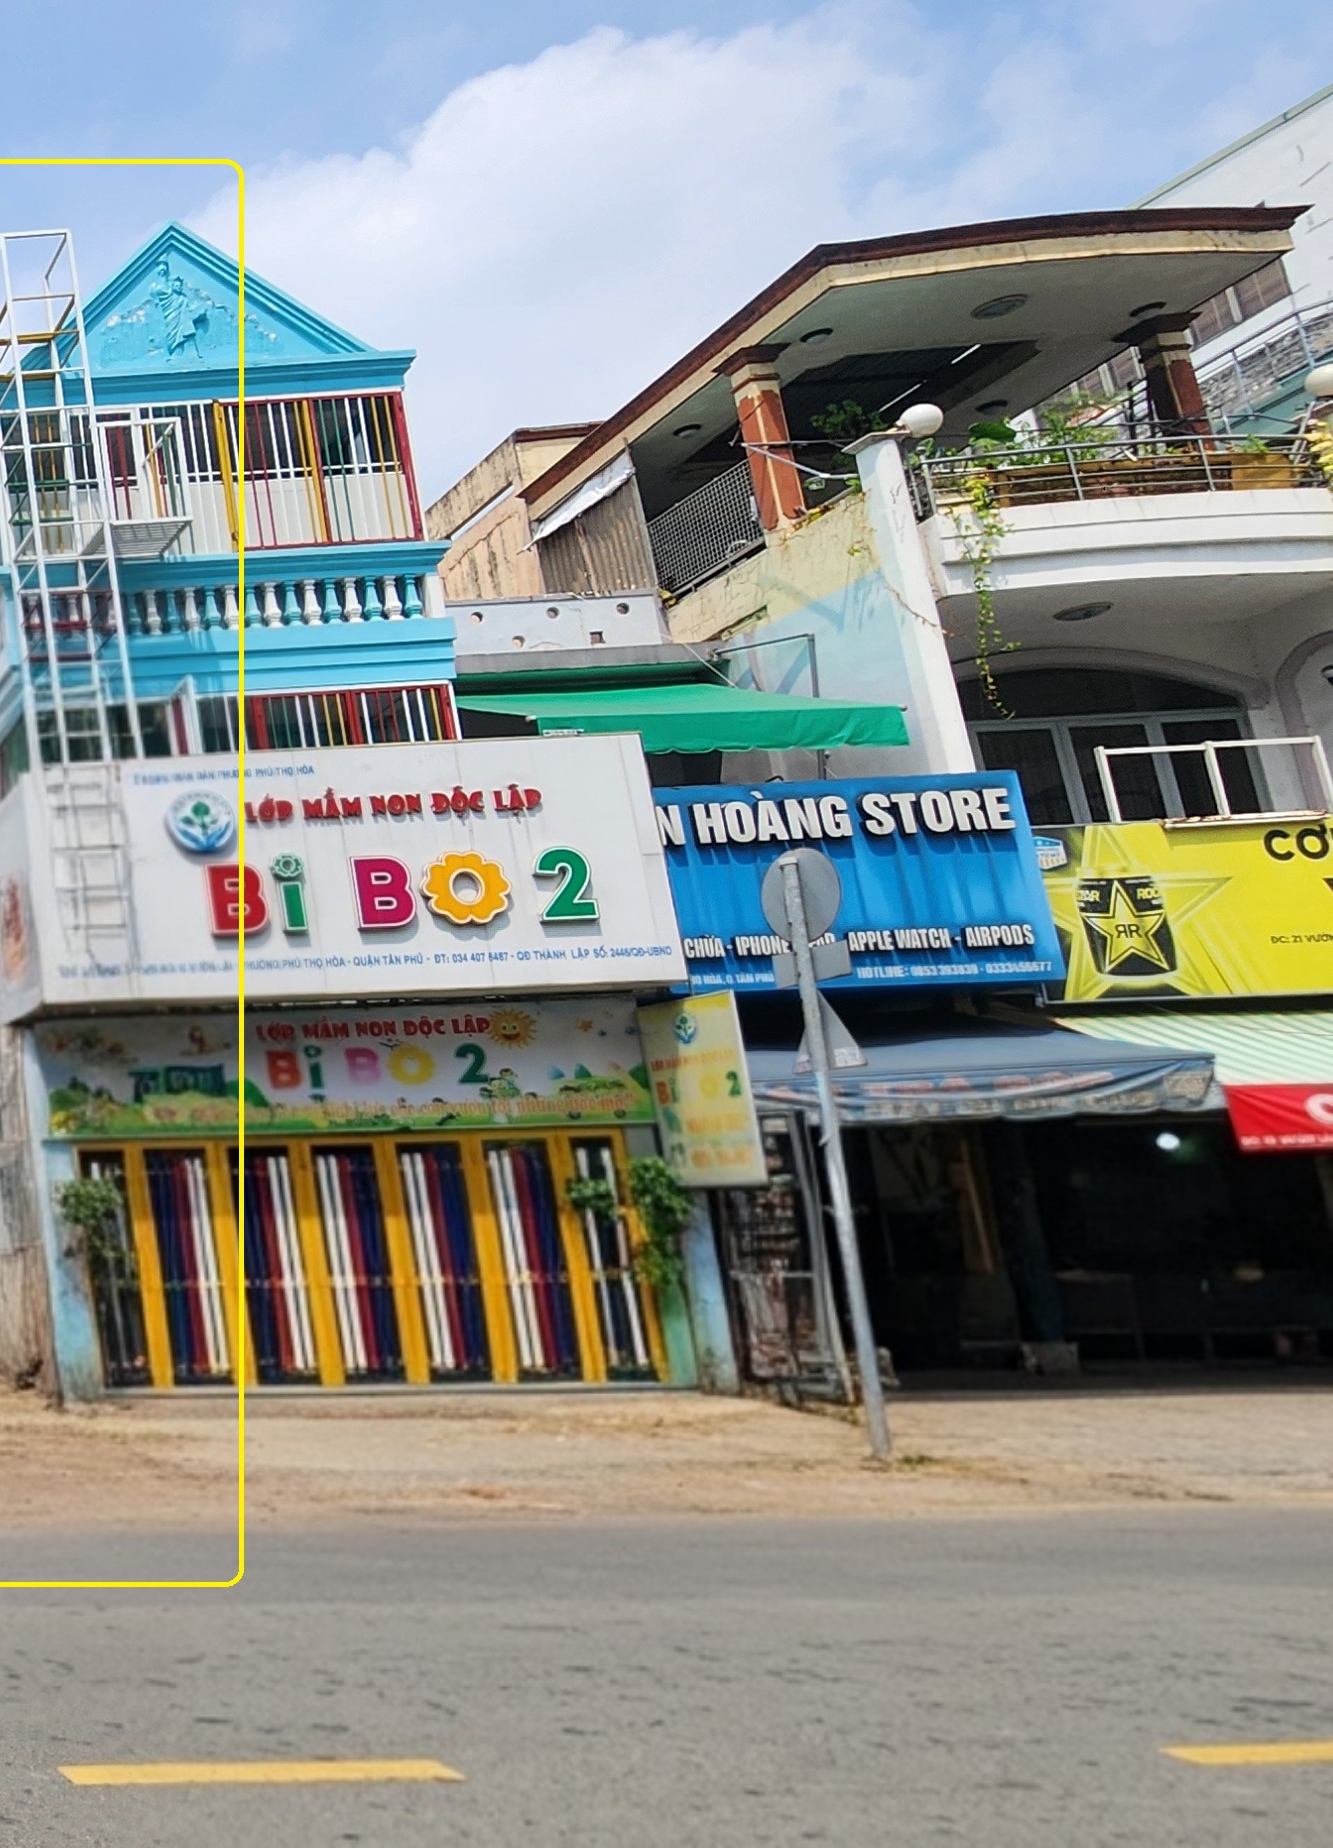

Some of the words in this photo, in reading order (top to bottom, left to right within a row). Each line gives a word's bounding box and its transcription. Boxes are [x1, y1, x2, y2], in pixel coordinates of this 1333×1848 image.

[275, 766, 293, 776] THỌ
[296, 764, 315, 775] HÒA
[369, 792, 423, 816] NON
[431, 785, 486, 819] ĐỘC
[493, 783, 543, 816] LẬP
[692, 790, 854, 844] HOÀNG
[861, 788, 1017, 836] STORE
[1264, 822, 1333, 862] CƠ
[532, 845, 601, 924] 2
[847, 929, 895, 951] APPLE
[894, 927, 952, 950] WATCH
[965, 924, 1035, 947] AIRPODS
[303, 957, 323, 971] THỌ
[325, 955, 347, 967] HÒA
[353, 954, 381, 969] QUẬN
[382, 953, 402, 966] TÂN
[404, 952, 424, 966] PHÚ
[452, 953, 469, 963] 034
[471, 952, 486, 962] 407
[533, 948, 566, 961] THÀNH
[570, 947, 590, 962] LẬP
[857, 966, 909, 979] HOTLINE:
[355, 1018, 398, 1038] NON
[403, 1015, 446, 1039] ĐỘC
[451, 1014, 491, 1038] LẬP
[453, 1042, 490, 1085] 2
